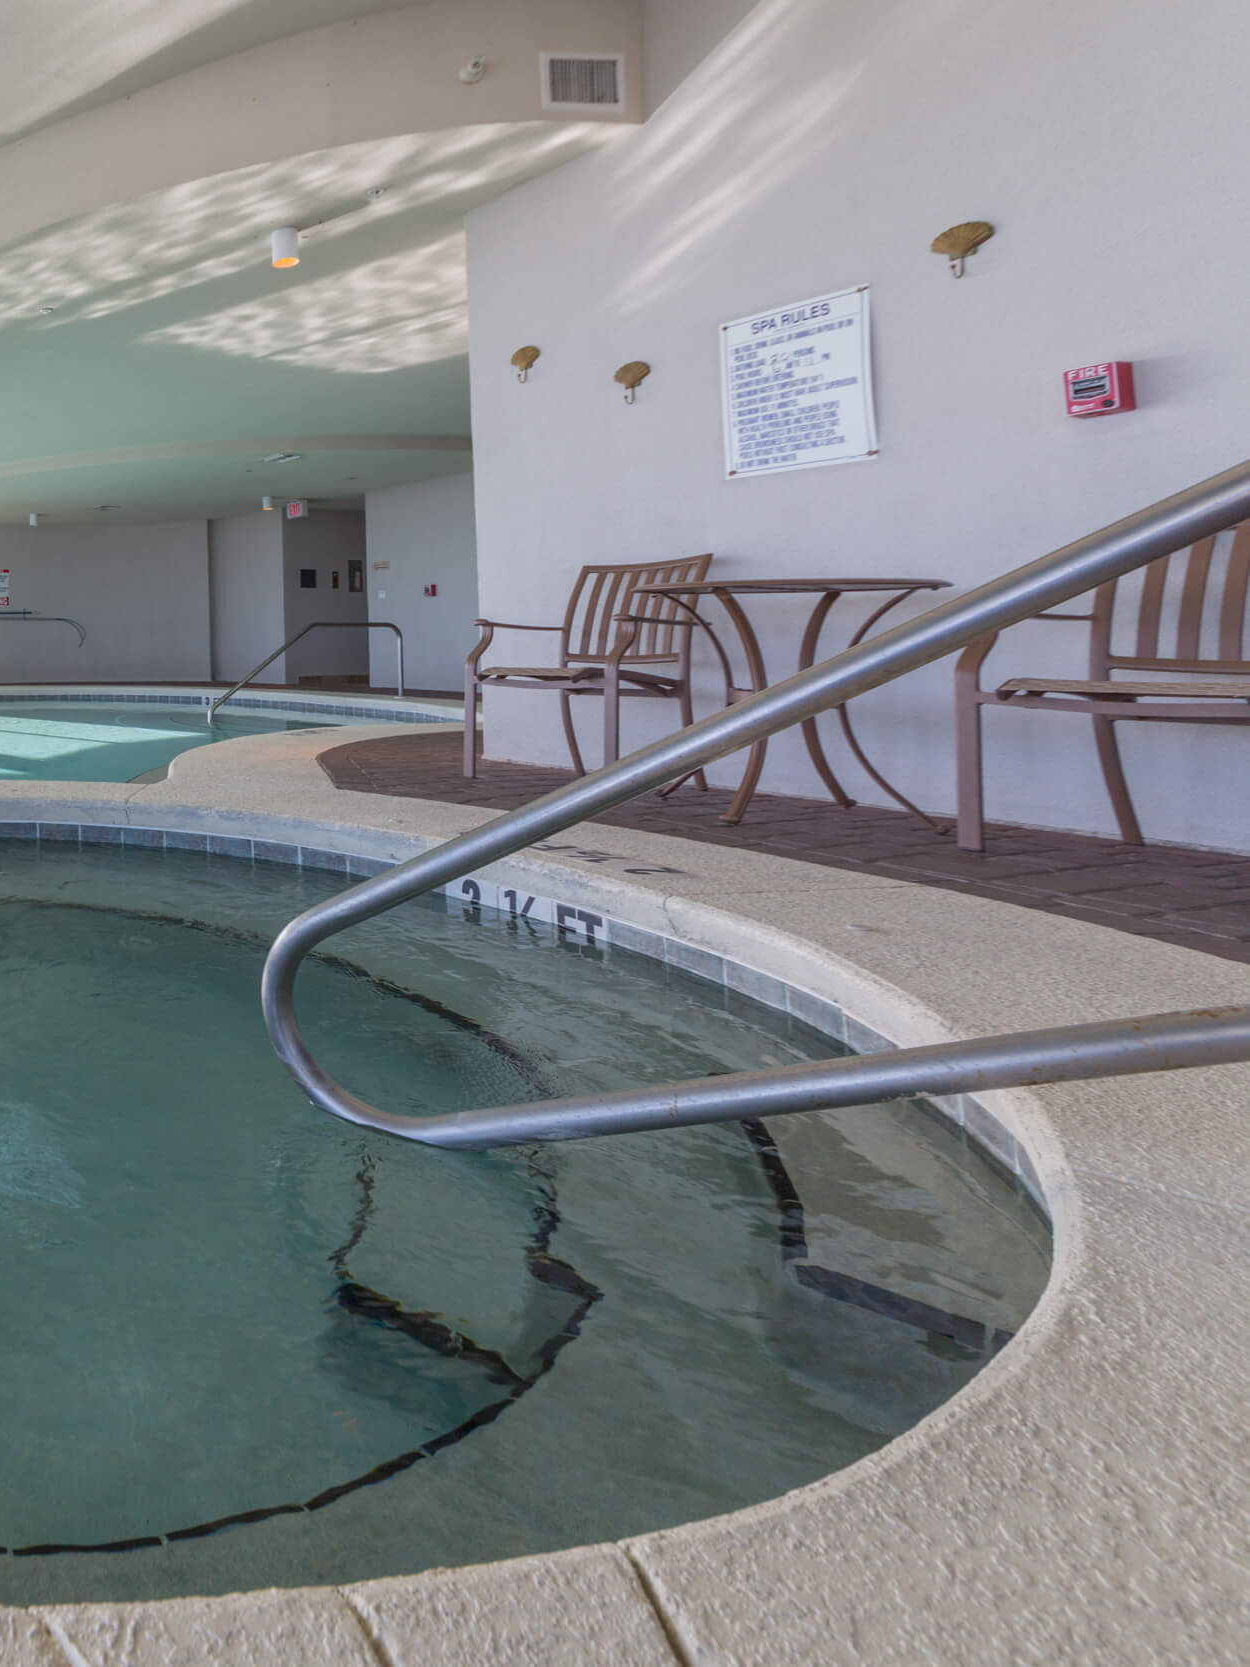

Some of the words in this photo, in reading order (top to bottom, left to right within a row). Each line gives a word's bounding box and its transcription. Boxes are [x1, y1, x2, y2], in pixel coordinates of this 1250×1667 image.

[751, 317, 777, 336] SPA
[780, 302, 831, 327] RULES
[1067, 363, 1111, 380] FIRE
[556, 903, 603, 945] FT
